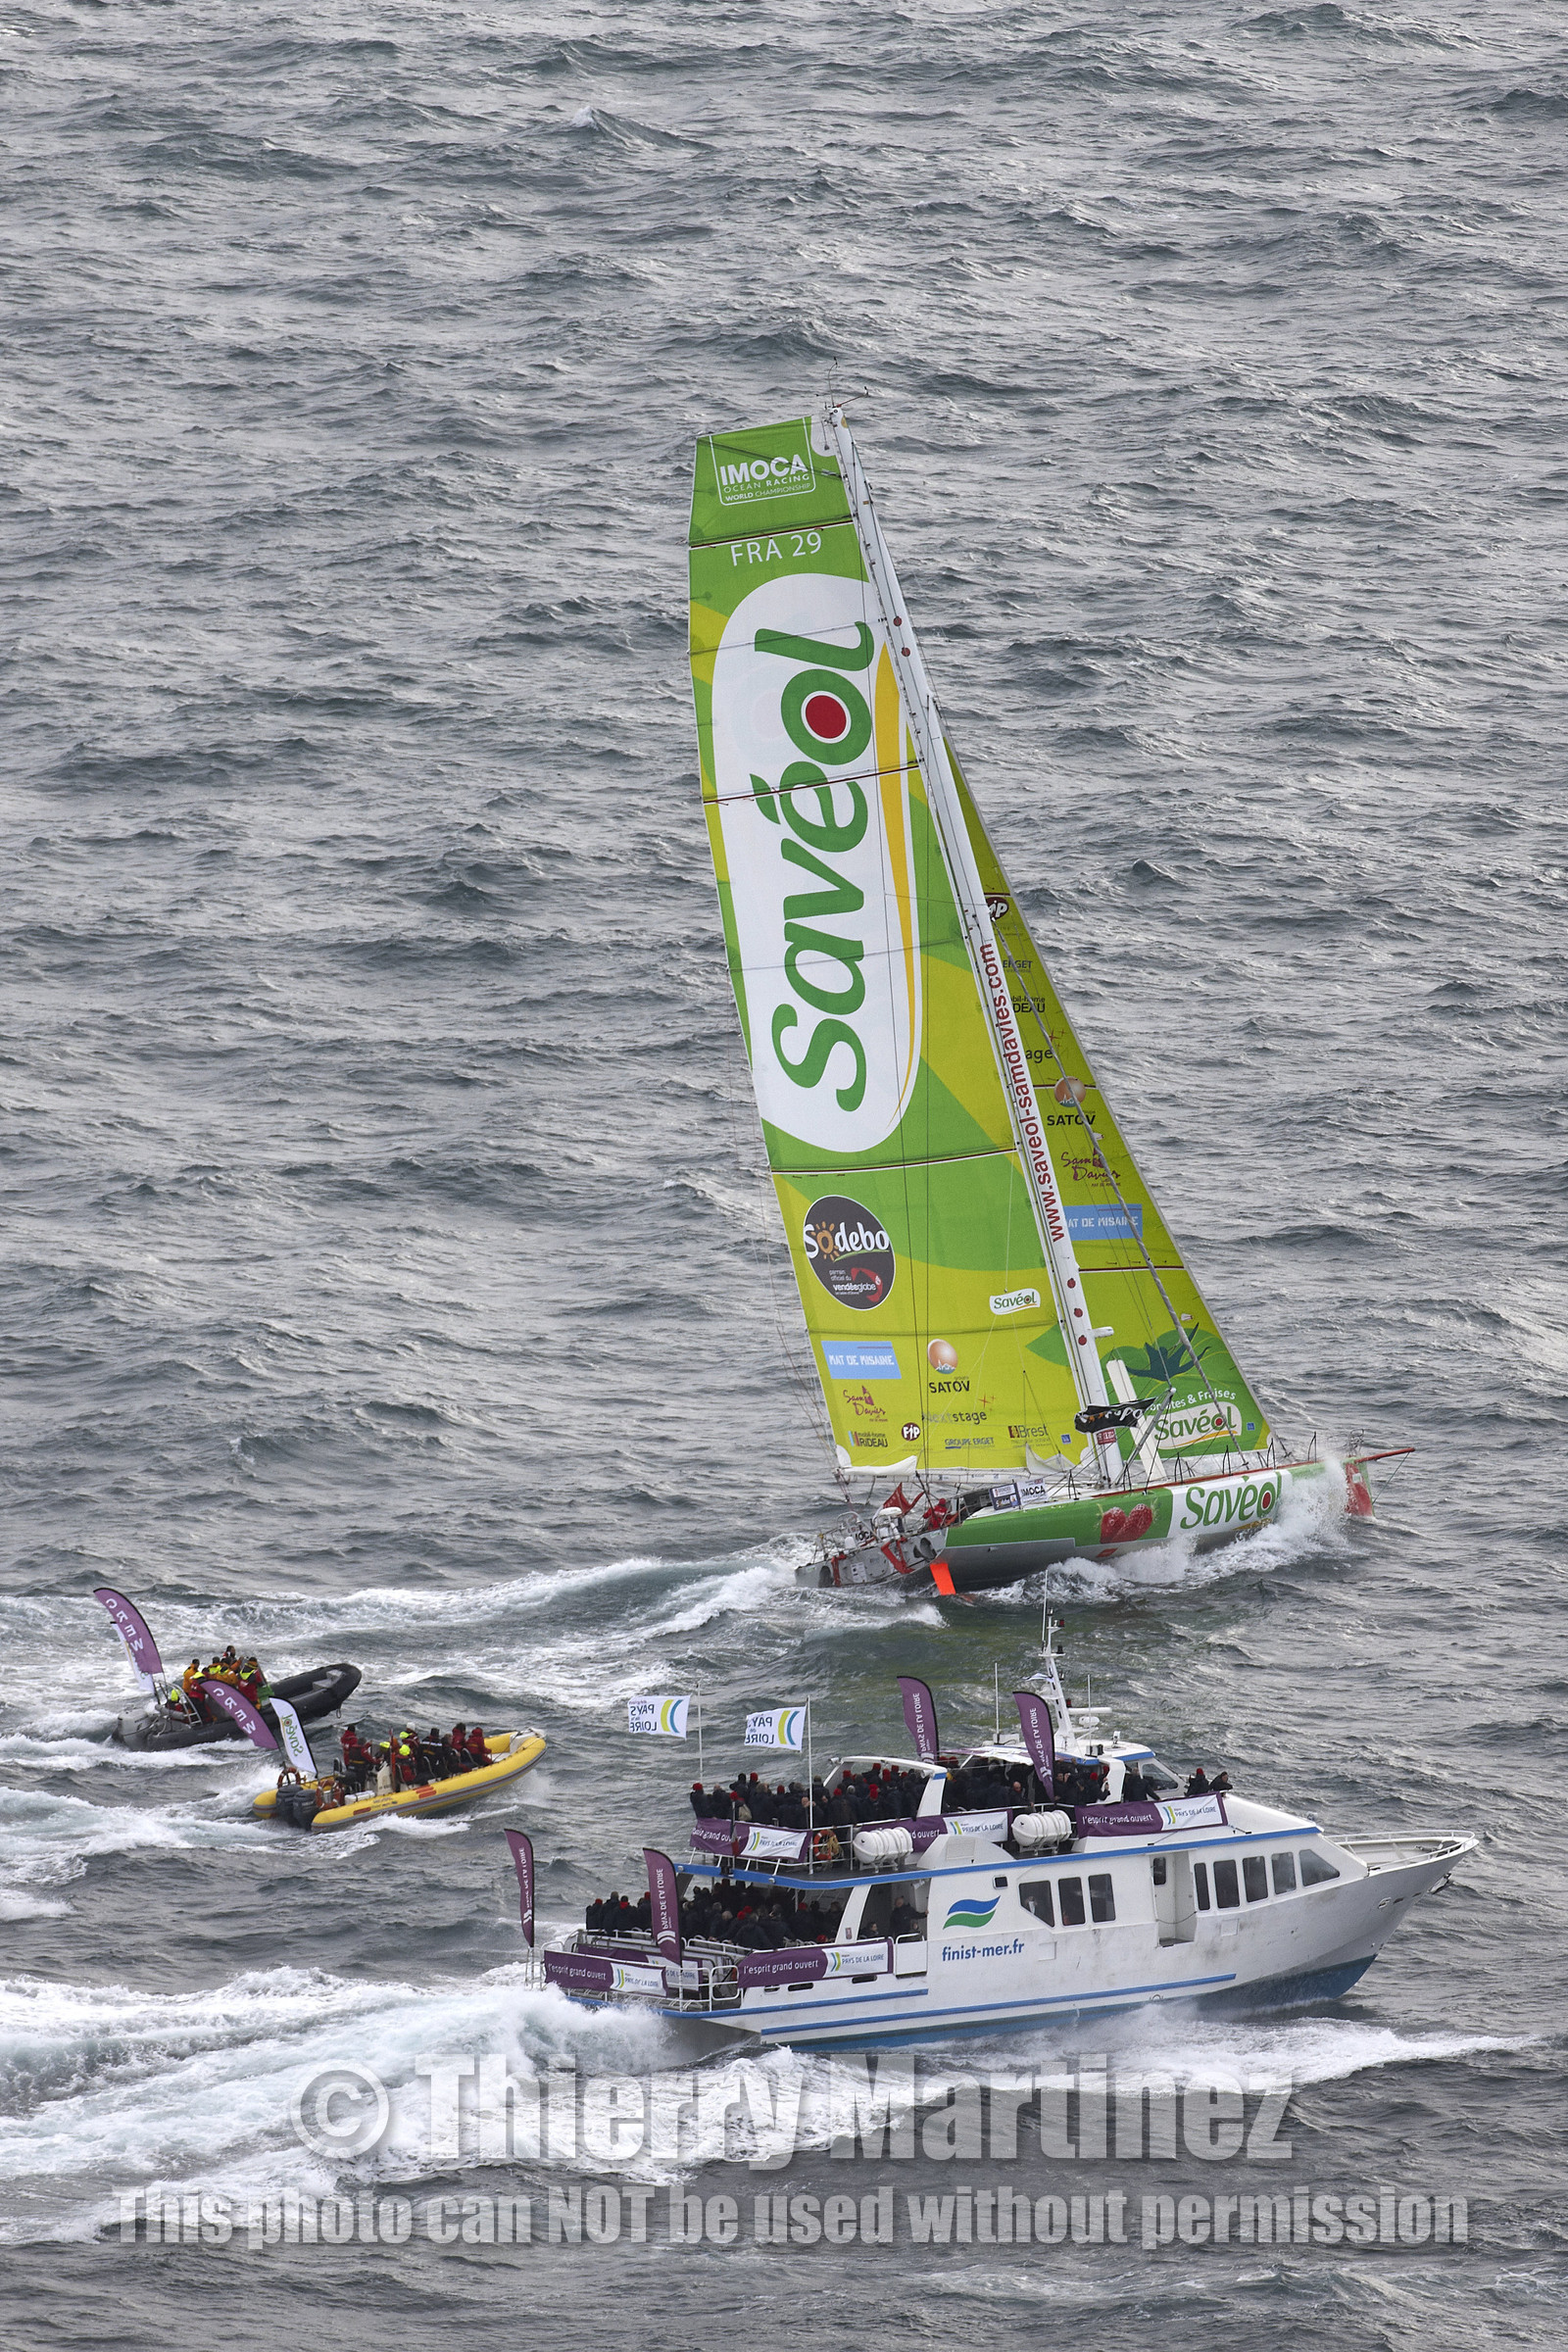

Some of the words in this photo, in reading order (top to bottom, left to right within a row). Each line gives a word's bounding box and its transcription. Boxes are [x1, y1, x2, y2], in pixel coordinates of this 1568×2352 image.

[720, 454, 808, 486] IMOCA
[723, 482, 761, 494] OCEAN
[765, 473, 809, 487] RACING
[725, 492, 754, 502] WORLD
[755, 483, 811, 497] CHAMPIONSHIP
[730, 538, 783, 566] FRA
[790, 531, 822, 557] 29
[750, 620, 875, 1112] Savéol
[980, 943, 1064, 1243] www.saveol-samdavies.com
[1068, 1218, 1079, 1228] AT
[1081, 1217, 1095, 1228] DE
[804, 1221, 890, 1259] Sodebo
[994, 1292, 1037, 1309] Savéol
[828, 1354, 845, 1365] MAT
[846, 1354, 859, 1365] DE
[860, 1354, 895, 1365] MISAINE
[928, 1380, 970, 1394] SATOV
[1187, 1394, 1198, 1403] &
[1017, 1423, 1049, 1439] Brest
[1154, 1405, 1237, 1441] Savéol
[918, 1829, 940, 1838] ouvert
[942, 1938, 1025, 1962] finist-mer.fr
[743, 1964, 771, 1975] l'esprit
[771, 1961, 793, 1974] grand
[794, 1960, 818, 1970] ouvert
